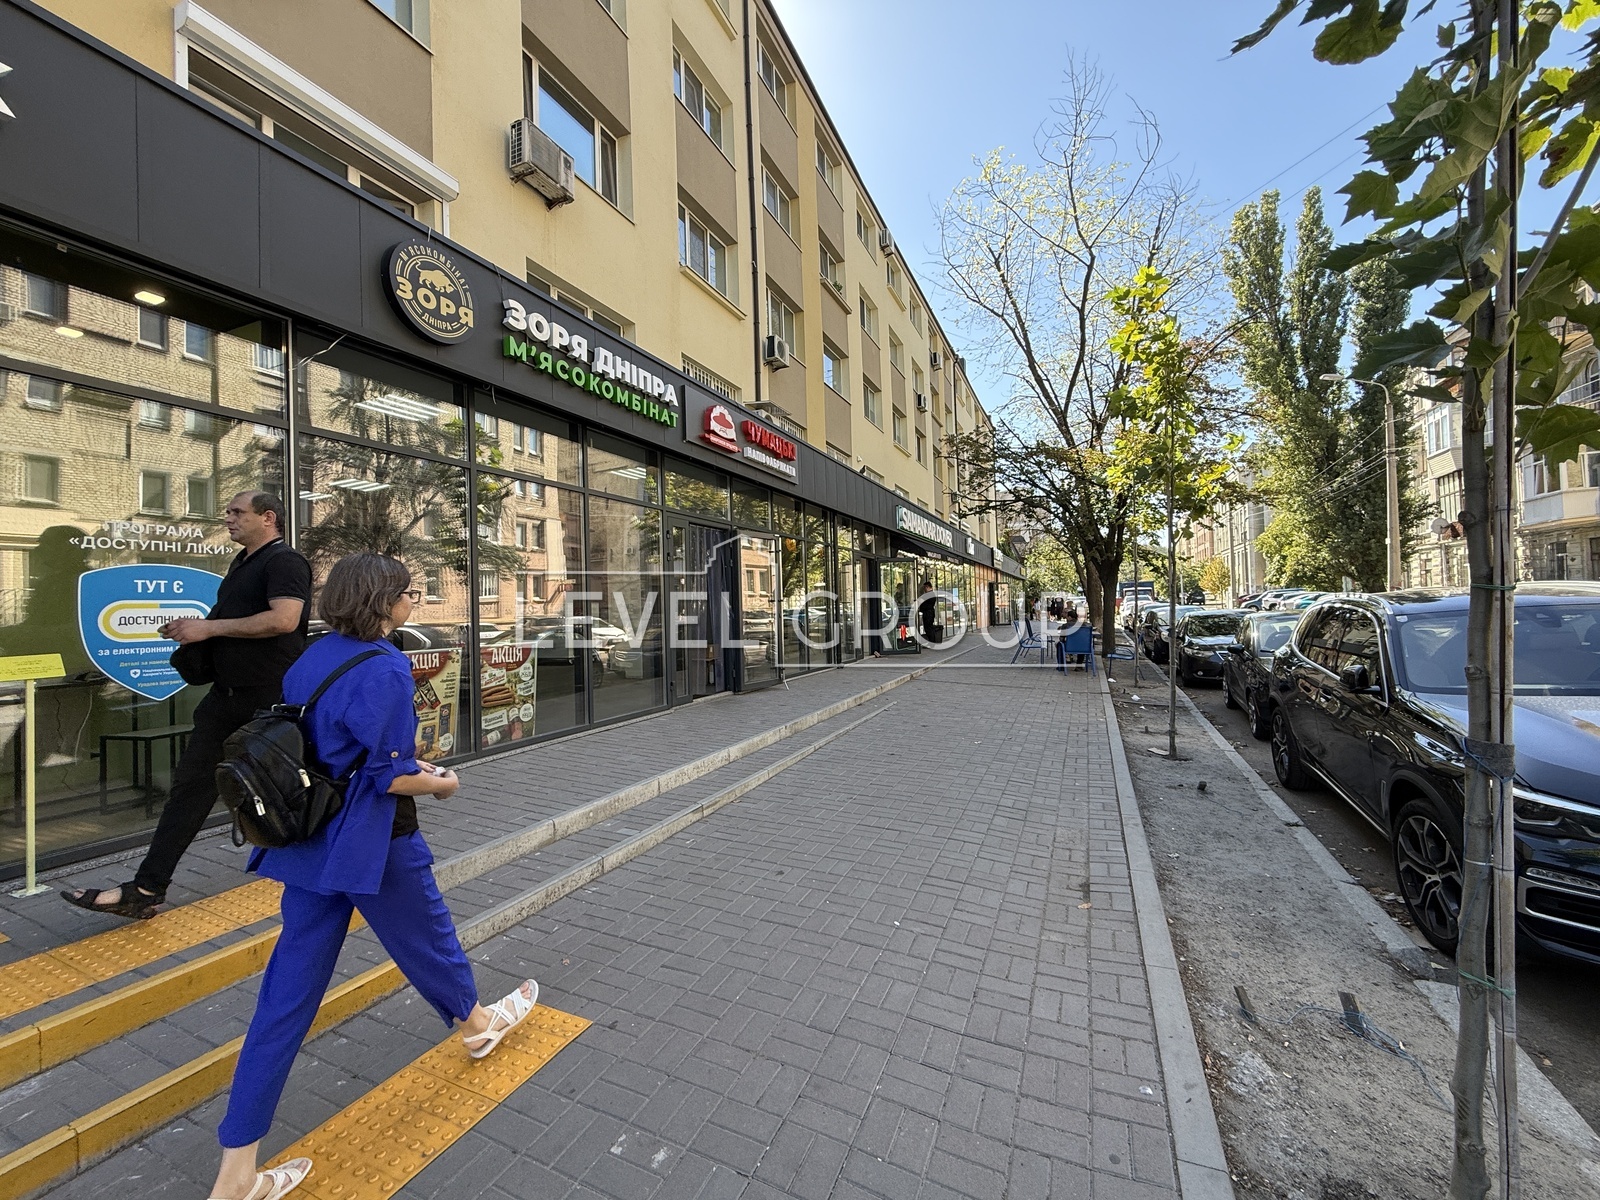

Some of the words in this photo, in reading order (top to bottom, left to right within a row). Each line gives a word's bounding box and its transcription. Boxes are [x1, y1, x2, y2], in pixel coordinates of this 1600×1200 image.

[396, 275, 474, 328] ЗОРЯ
[421, 312, 453, 331] ДНІПРА
[502, 298, 589, 363] ЗОРЯ
[591, 346, 680, 407] ДНІПРА
[103, 521, 204, 538] ПРОГРАМА
[69, 536, 181, 553] «ДОСТУПНІ
[185, 543, 233, 555] ЛІКИ»
[134, 580, 168, 593] ТУТ
[173, 581, 184, 593] Є
[112, 645, 174, 656] електронним
[491, 645, 523, 664] АКЦІЯ
[411, 652, 440, 670] КЦІЯ
